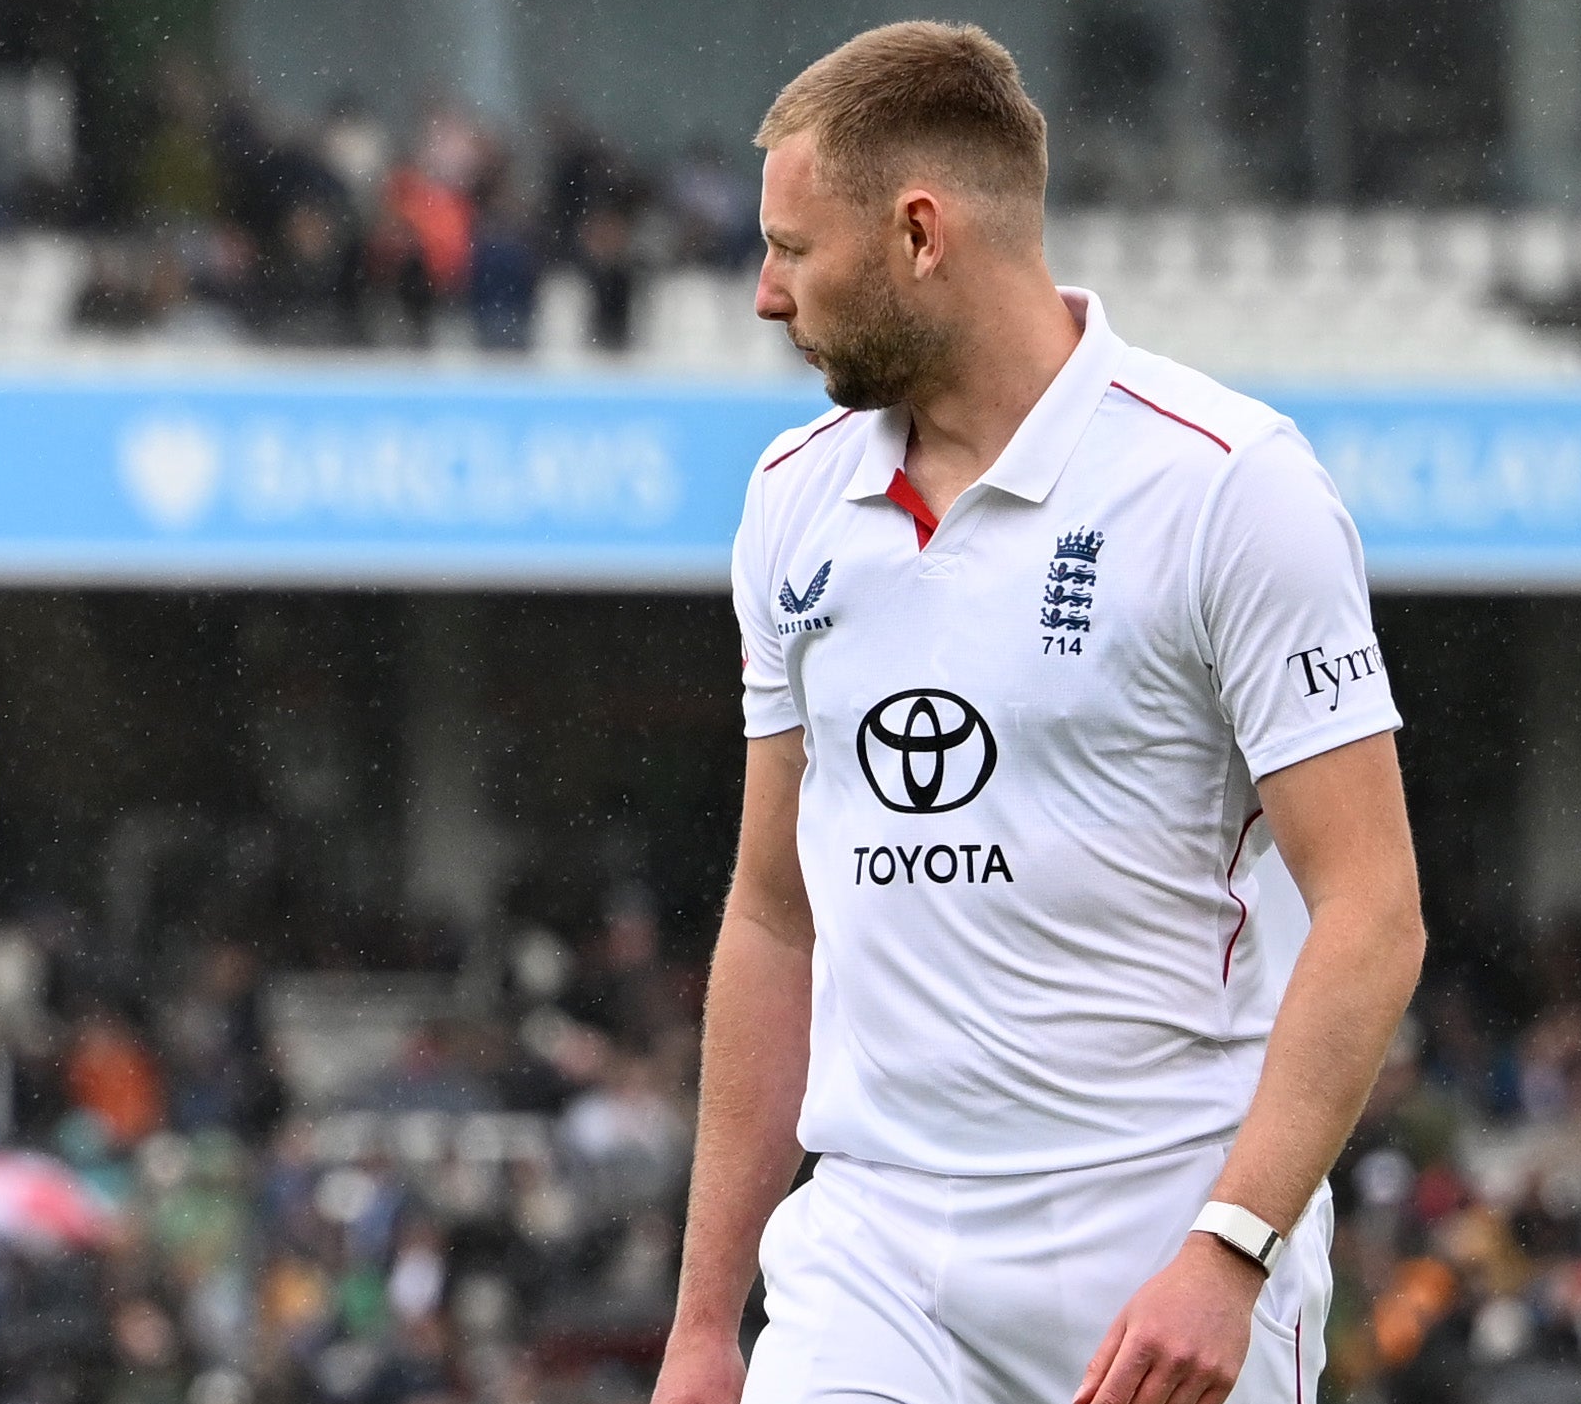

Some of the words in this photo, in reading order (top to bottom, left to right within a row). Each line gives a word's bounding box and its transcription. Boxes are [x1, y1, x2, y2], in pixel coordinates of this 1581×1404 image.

[233, 415, 681, 526] BARCLAYS
[778, 616, 833, 635] CASTORE
[1042, 636, 1083, 655] 714
[854, 844, 1014, 885] TOYOTA
